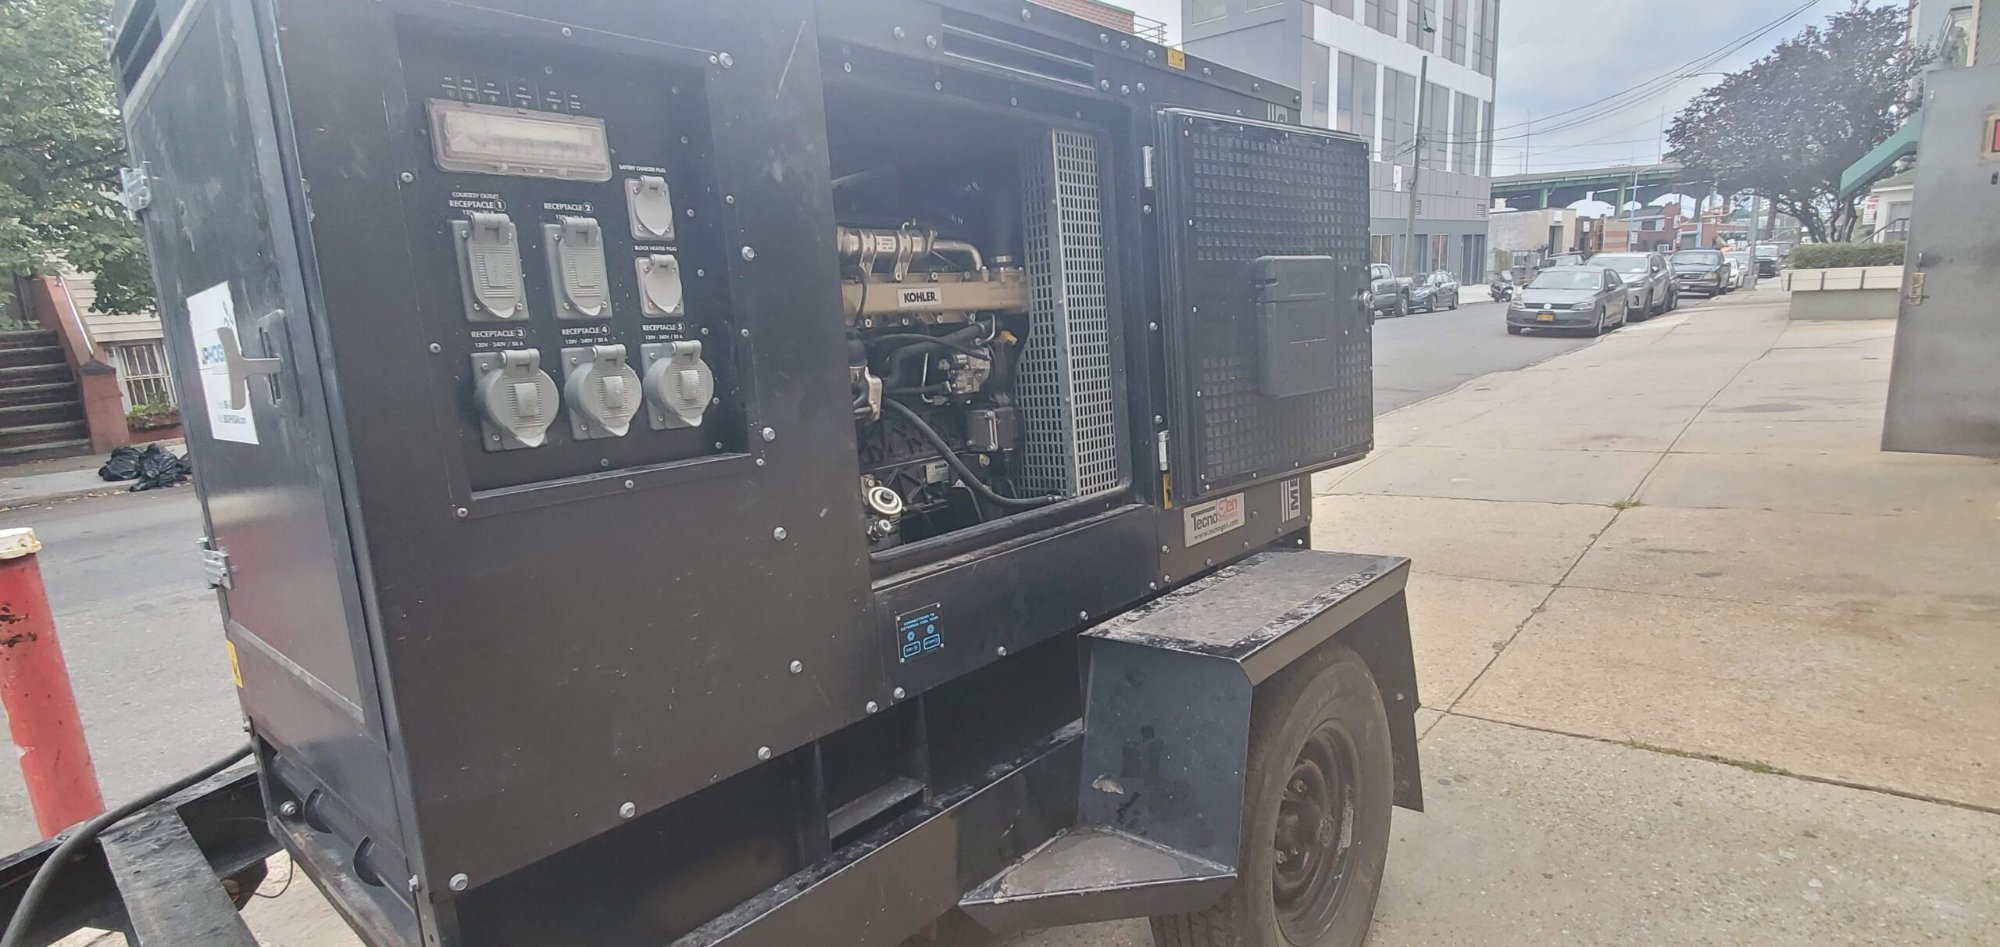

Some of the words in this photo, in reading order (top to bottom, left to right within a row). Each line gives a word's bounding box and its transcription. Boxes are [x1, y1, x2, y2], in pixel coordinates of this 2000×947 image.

[449, 200, 494, 209] RECEPTACLE
[543, 202, 583, 211] RECEPTACLE
[471, 330, 515, 338] RECEPTACLE
[561, 327, 601, 335] RECEPTACLE
